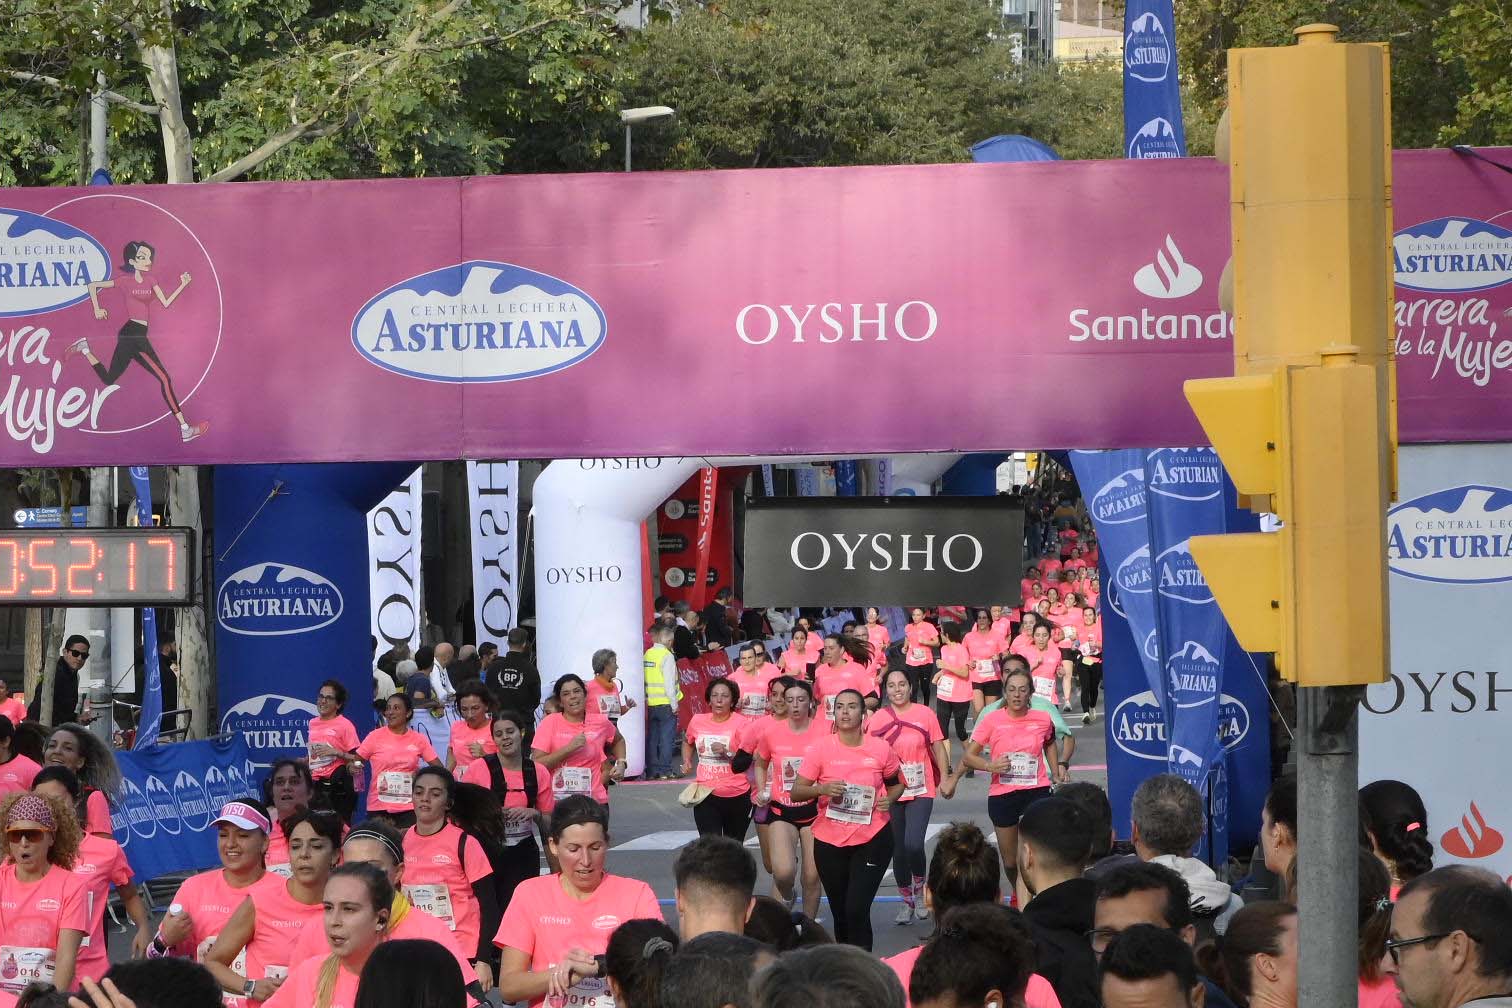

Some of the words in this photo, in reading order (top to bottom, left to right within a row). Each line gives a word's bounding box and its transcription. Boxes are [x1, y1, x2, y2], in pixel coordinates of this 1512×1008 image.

[14, 244, 87, 256] LECHERA
[1465, 241, 1512, 250] LECHER
[411, 303, 488, 316] CENTRAL
[497, 302, 578, 314] LECHERA
[735, 301, 939, 344] OYSHO
[1394, 298, 1489, 327] arrera
[372, 309, 587, 353] ASTURIANA
[1069, 309, 1234, 341] Santand
[1418, 328, 1436, 355] la
[1431, 322, 1512, 387] Muje
[1415, 519, 1482, 530] CENTRAL
[476, 461, 512, 637] OYSH
[790, 532, 984, 573] OYSHO
[374, 485, 415, 645] OYS
[547, 566, 622, 585] OYSHO
[221, 592, 334, 619] ASTURIANA
[234, 587, 276, 596] CENTRAL
[281, 587, 329, 595] LECHERA
[1359, 671, 1512, 715] OYSH
[236, 719, 276, 728] CENTRAL
[281, 719, 310, 727] LECH
[570, 994, 597, 1007] 016
